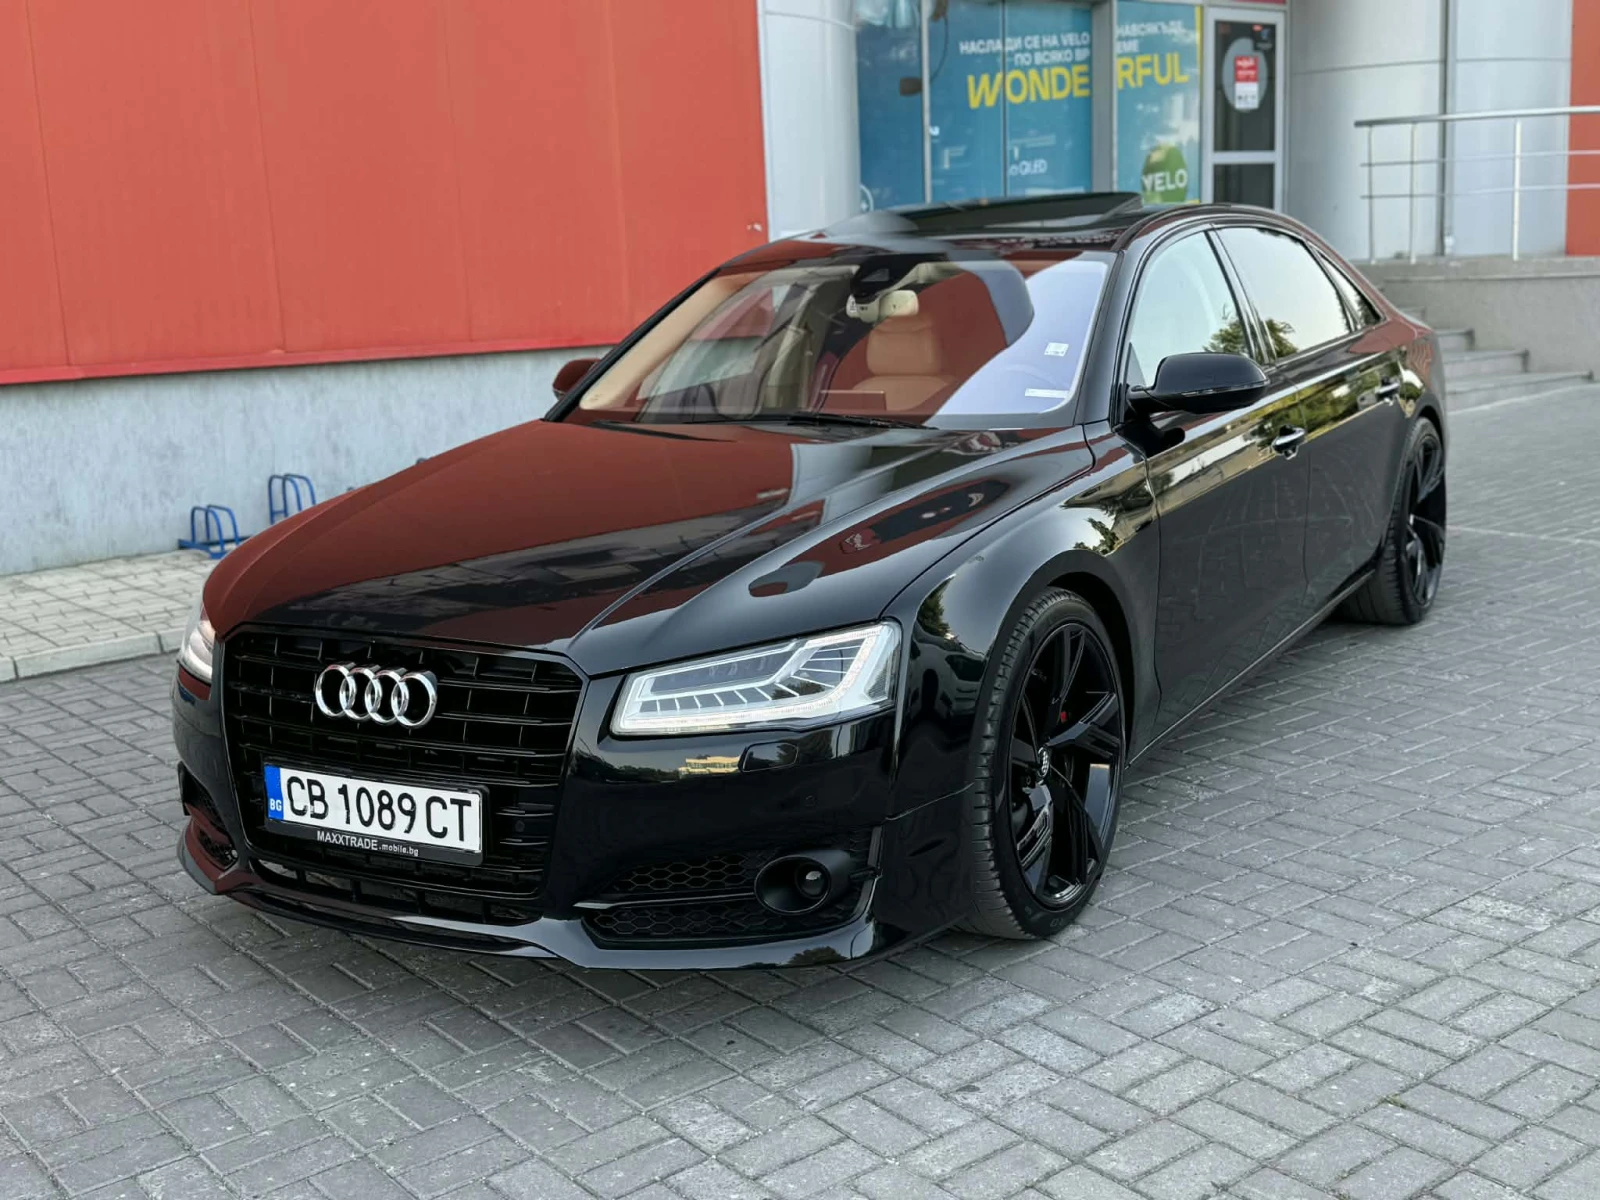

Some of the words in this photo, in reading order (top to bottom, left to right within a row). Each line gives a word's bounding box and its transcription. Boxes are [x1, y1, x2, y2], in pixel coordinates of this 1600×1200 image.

[1024, 34, 1041, 50] СЕ
[1042, 34, 1059, 49] НА
[1060, 31, 1090, 47] VELO
[269, 797, 282, 812] BG
[286, 776, 329, 820] CB
[337, 783, 417, 834] 1089
[425, 796, 472, 842] CT
